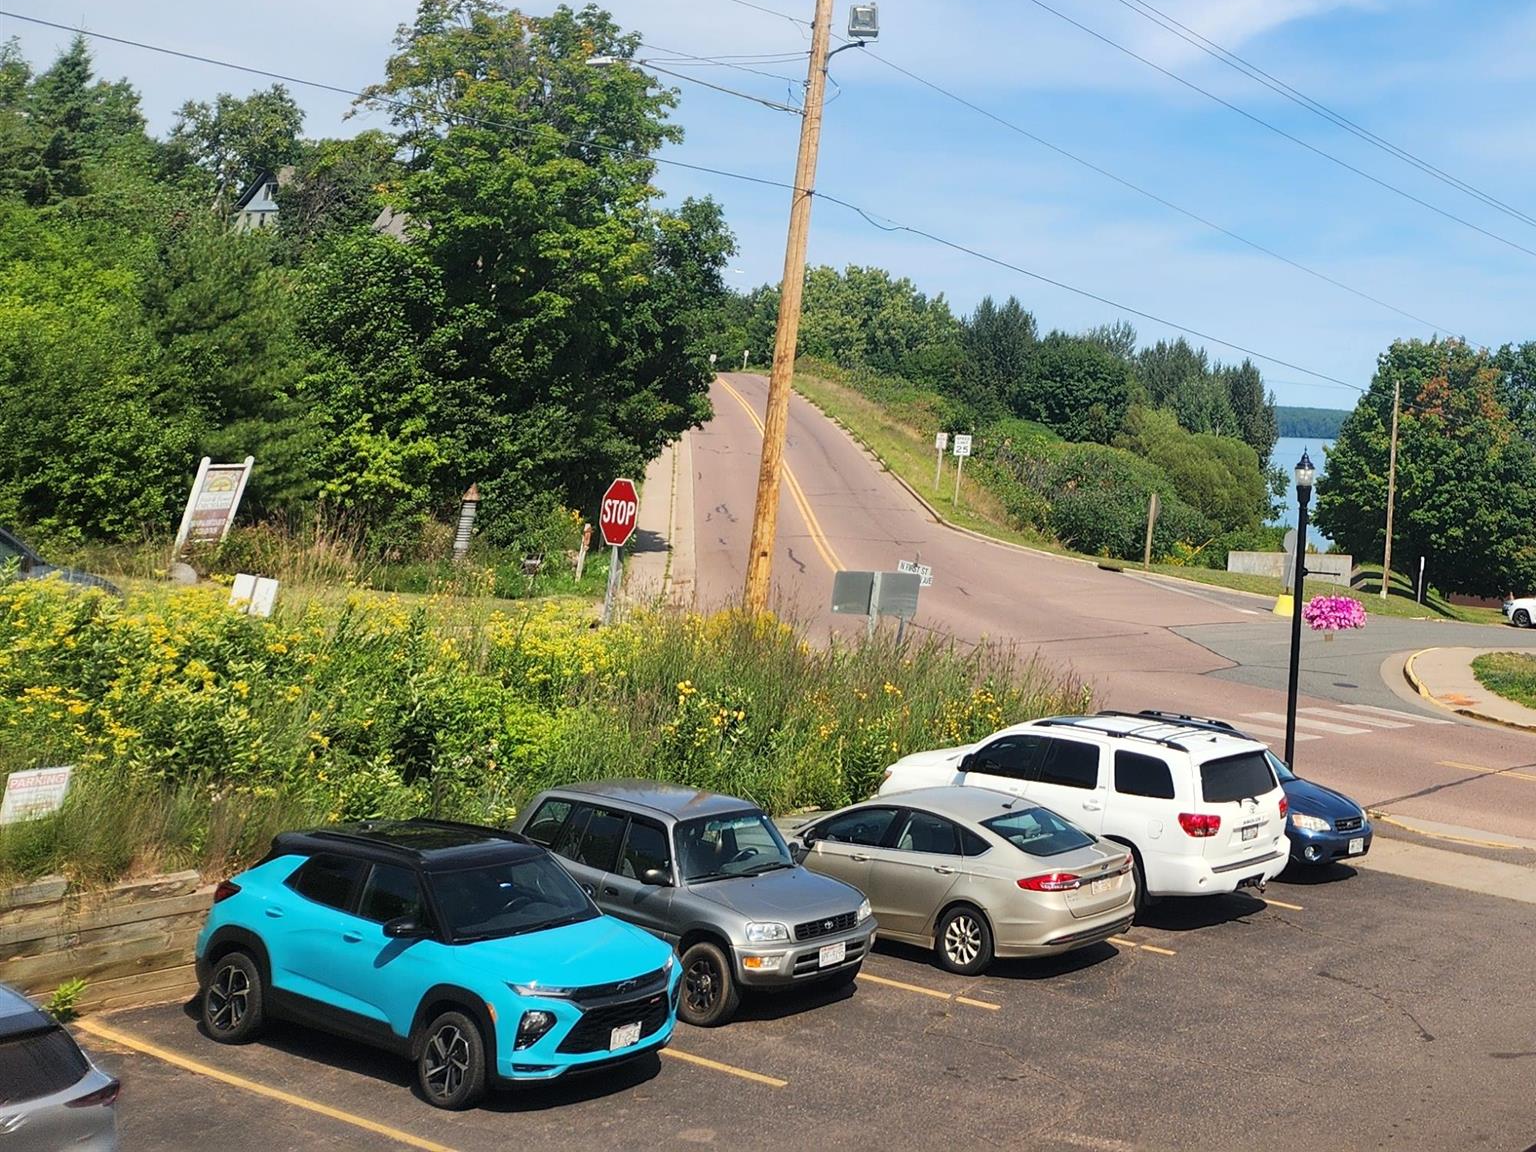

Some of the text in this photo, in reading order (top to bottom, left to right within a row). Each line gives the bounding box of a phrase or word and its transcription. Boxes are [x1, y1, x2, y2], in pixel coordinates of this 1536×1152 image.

[956, 445, 969, 453] 25
[603, 498, 635, 525] STOP
[920, 567, 929, 575] ST
[9, 773, 65, 789] PARKING
